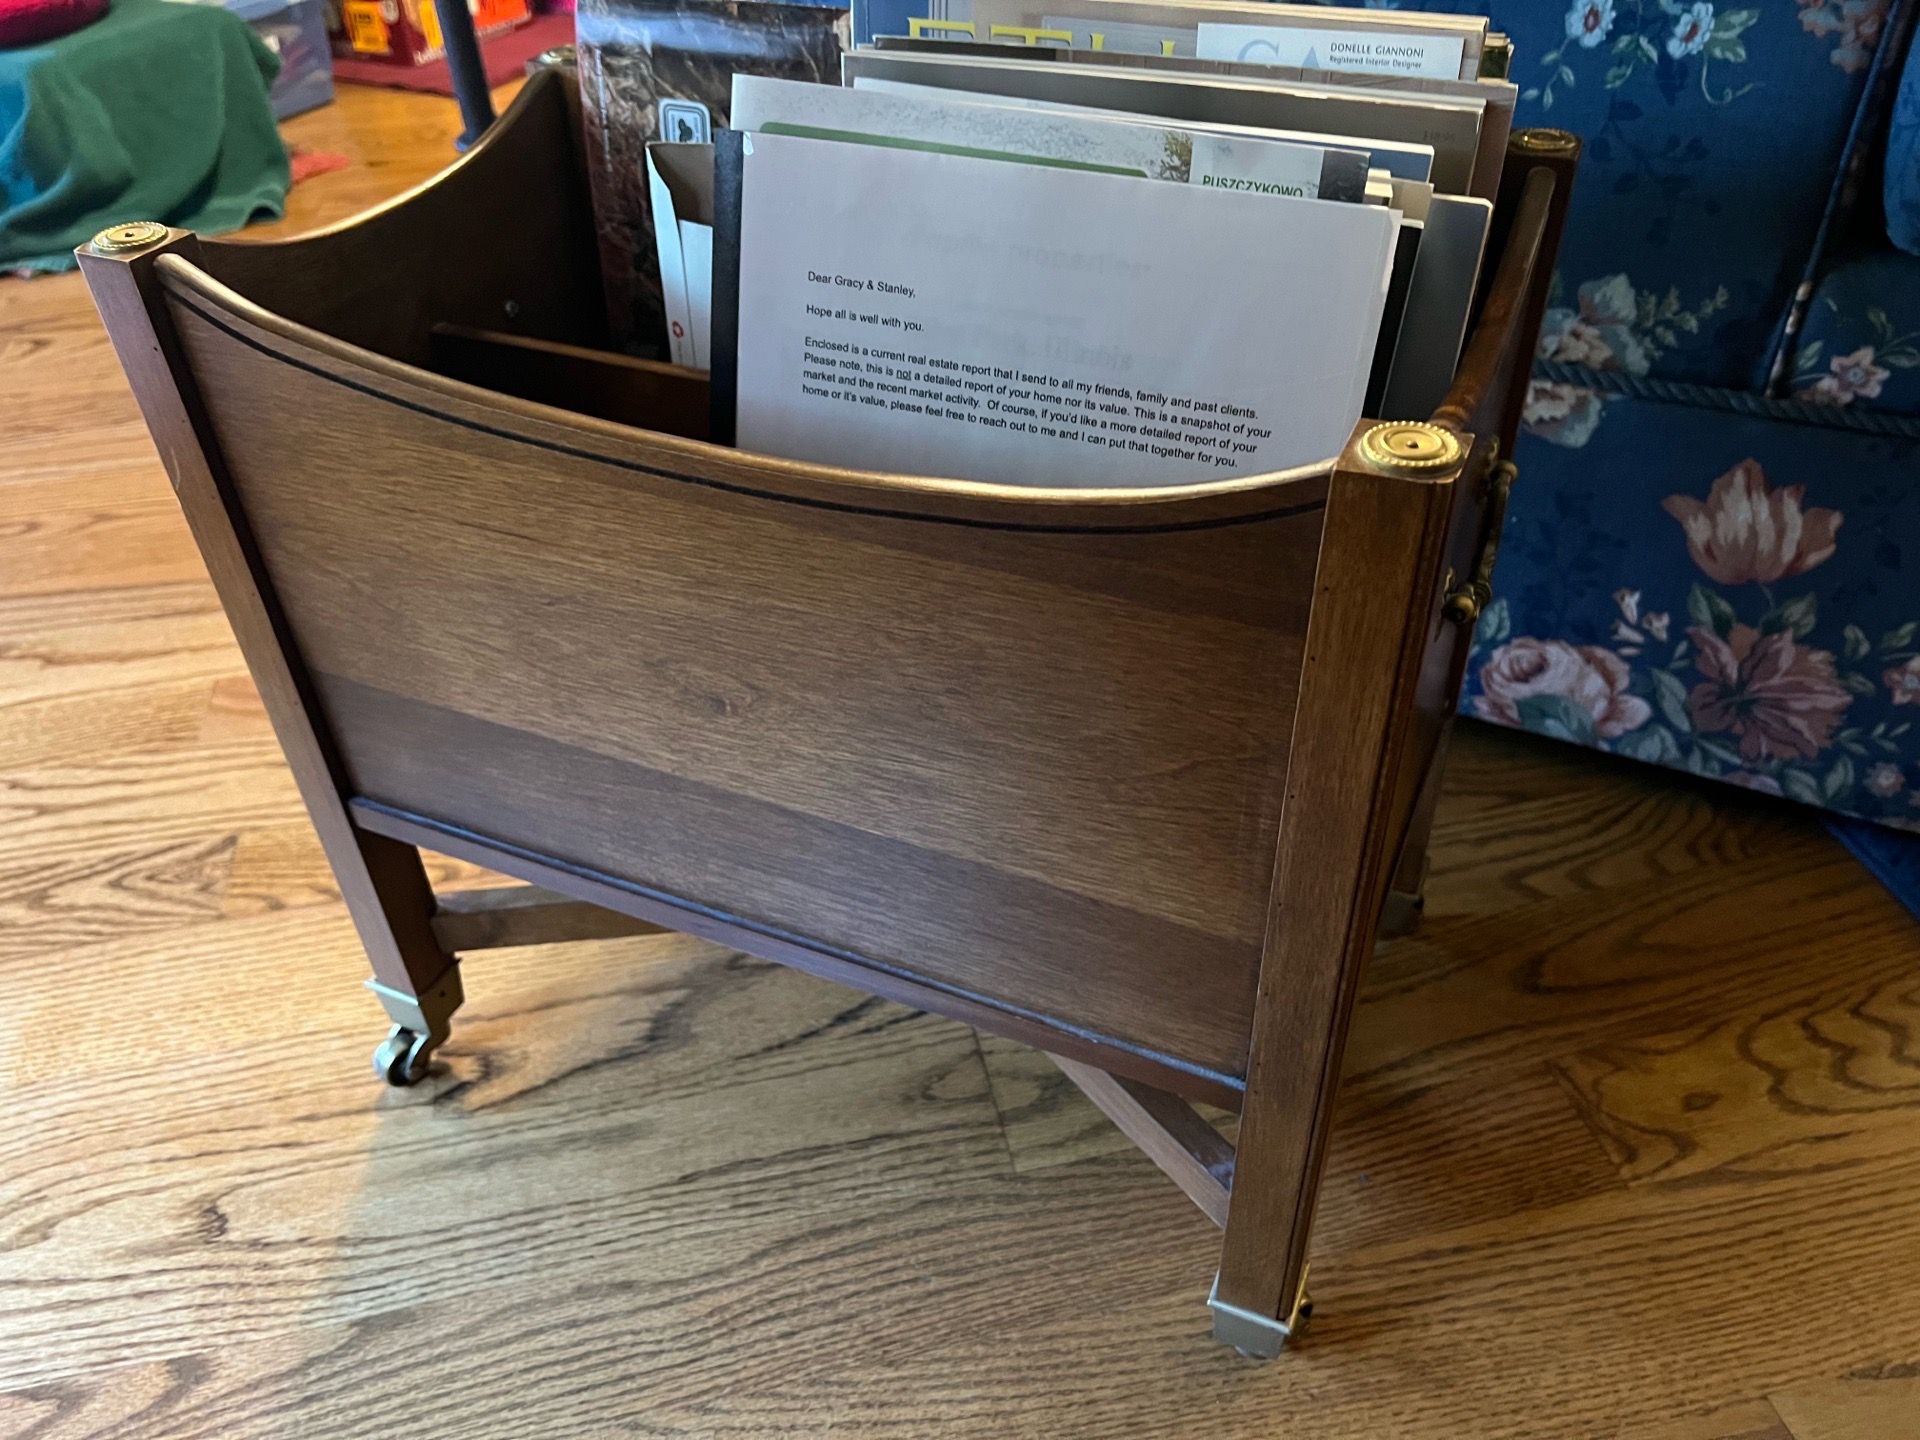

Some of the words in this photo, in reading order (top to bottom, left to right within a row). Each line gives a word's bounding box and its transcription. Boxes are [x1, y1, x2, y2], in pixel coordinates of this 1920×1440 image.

[1329, 55, 1364, 65] Registered
[1365, 57, 1390, 66] Interior
[1392, 59, 1422, 69] Designer
[1330, 42, 1371, 55] DONELLE
[1375, 45, 1424, 58] GIANNONI
[808, 270, 832, 284] Dear
[834, 275, 864, 291] Gracy
[866, 279, 874, 291] &
[877, 281, 916, 298] Stanley,
[806, 304, 833, 318] Hope
[834, 309, 846, 319] all
[849, 310, 857, 321] is
[859, 314, 879, 325] well
[881, 316, 901, 328] with
[903, 320, 924, 332] you.
[804, 352, 837, 367] Please
[839, 360, 863, 373] note,
[866, 362, 883, 375] this
[885, 365, 894, 377] is
[895, 369, 912, 382] not
[914, 372, 921, 381] a
[923, 372, 962, 388] detailed
[964, 380, 994, 396] report
[996, 384, 1007, 396] of
[1008, 388, 1032, 401] your
[1033, 390, 1062, 404] home
[1064, 397, 1083, 408] nor
[1084, 398, 1096, 411] its
[1099, 403, 1130, 416] value.
[1134, 406, 1156, 421] This
[1158, 409, 1168, 423] is
[1170, 415, 1178, 424] a
[1180, 416, 1231, 433] snapshot
[1233, 423, 1246, 435] of
[1246, 427, 1272, 439] your
[805, 336, 849, 353] Enclosed
[851, 343, 860, 355] is
[862, 347, 869, 356] a
[870, 349, 905, 362] current
[907, 355, 926, 365] real
[928, 358, 959, 371] estate
[961, 363, 991, 377] report
[993, 367, 1013, 380] that
[1015, 370, 1019, 381] I
[1021, 374, 1047, 386] send
[1049, 376, 1059, 388] to
[1061, 379, 1074, 390] all
[1076, 382, 1093, 396] my
[1095, 383, 1133, 401] friends,
[1136, 389, 1168, 408] family
[1170, 397, 1192, 409] and
[1193, 401, 1218, 414] past
[1220, 404, 1258, 420] clients.
[802, 383, 829, 398] home
[831, 390, 842, 399] or
[843, 390, 857, 402] it's
[859, 395, 888, 409] value,
[890, 399, 923, 414] please
[925, 404, 943, 417] feel
[945, 408, 965, 421] free
[967, 412, 977, 423] to
[979, 416, 1007, 429] reach
[1009, 421, 1026, 432] out
[1028, 423, 1038, 434] to
[1040, 426, 1057, 437] me
[1059, 430, 1079, 441] and
[1081, 431, 1085, 442] I
[1087, 434, 1106, 446] can
[1108, 438, 1126, 449] put
[1128, 439, 1149, 453] that
[1151, 443, 1196, 460] together
[1197, 450, 1213, 463] for
[1214, 456, 1238, 468] you.
[803, 370, 836, 383] market
[838, 376, 857, 387] and
[859, 377, 874, 390] the
[876, 382, 907, 395] recent
[909, 388, 943, 402] market
[945, 393, 981, 410] activity.
[986, 398, 1001, 411] Of
[1001, 401, 1038, 420] course,
[1041, 408, 1049, 419] if
[1049, 411, 1078, 424] you'd
[1080, 414, 1098, 428] like
[1100, 420, 1107, 430] a
[1109, 421, 1137, 434] more
[1139, 424, 1182, 442] detailed
[1184, 433, 1217, 449] report
[1218, 438, 1232, 450] of
[1232, 440, 1258, 454] your
